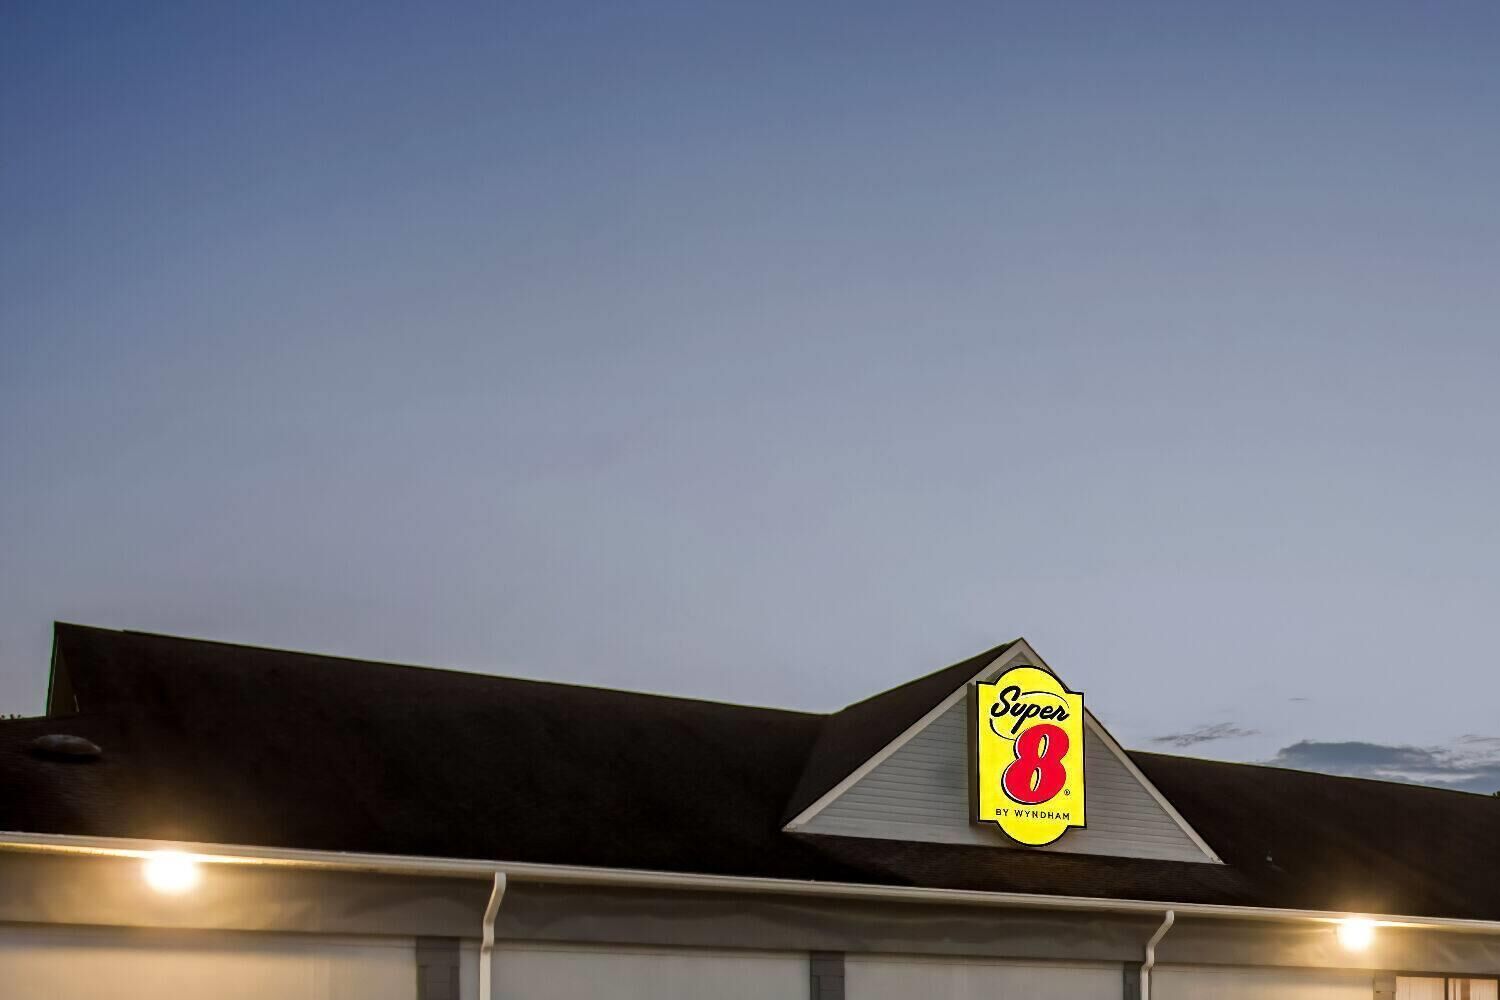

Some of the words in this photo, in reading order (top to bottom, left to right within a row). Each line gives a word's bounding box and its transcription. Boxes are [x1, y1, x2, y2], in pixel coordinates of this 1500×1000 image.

[990, 685, 1070, 735] Super
[1001, 723, 1070, 806] 8
[995, 808, 1009, 817] BY
[1014, 809, 1070, 821] WYNDHAM
